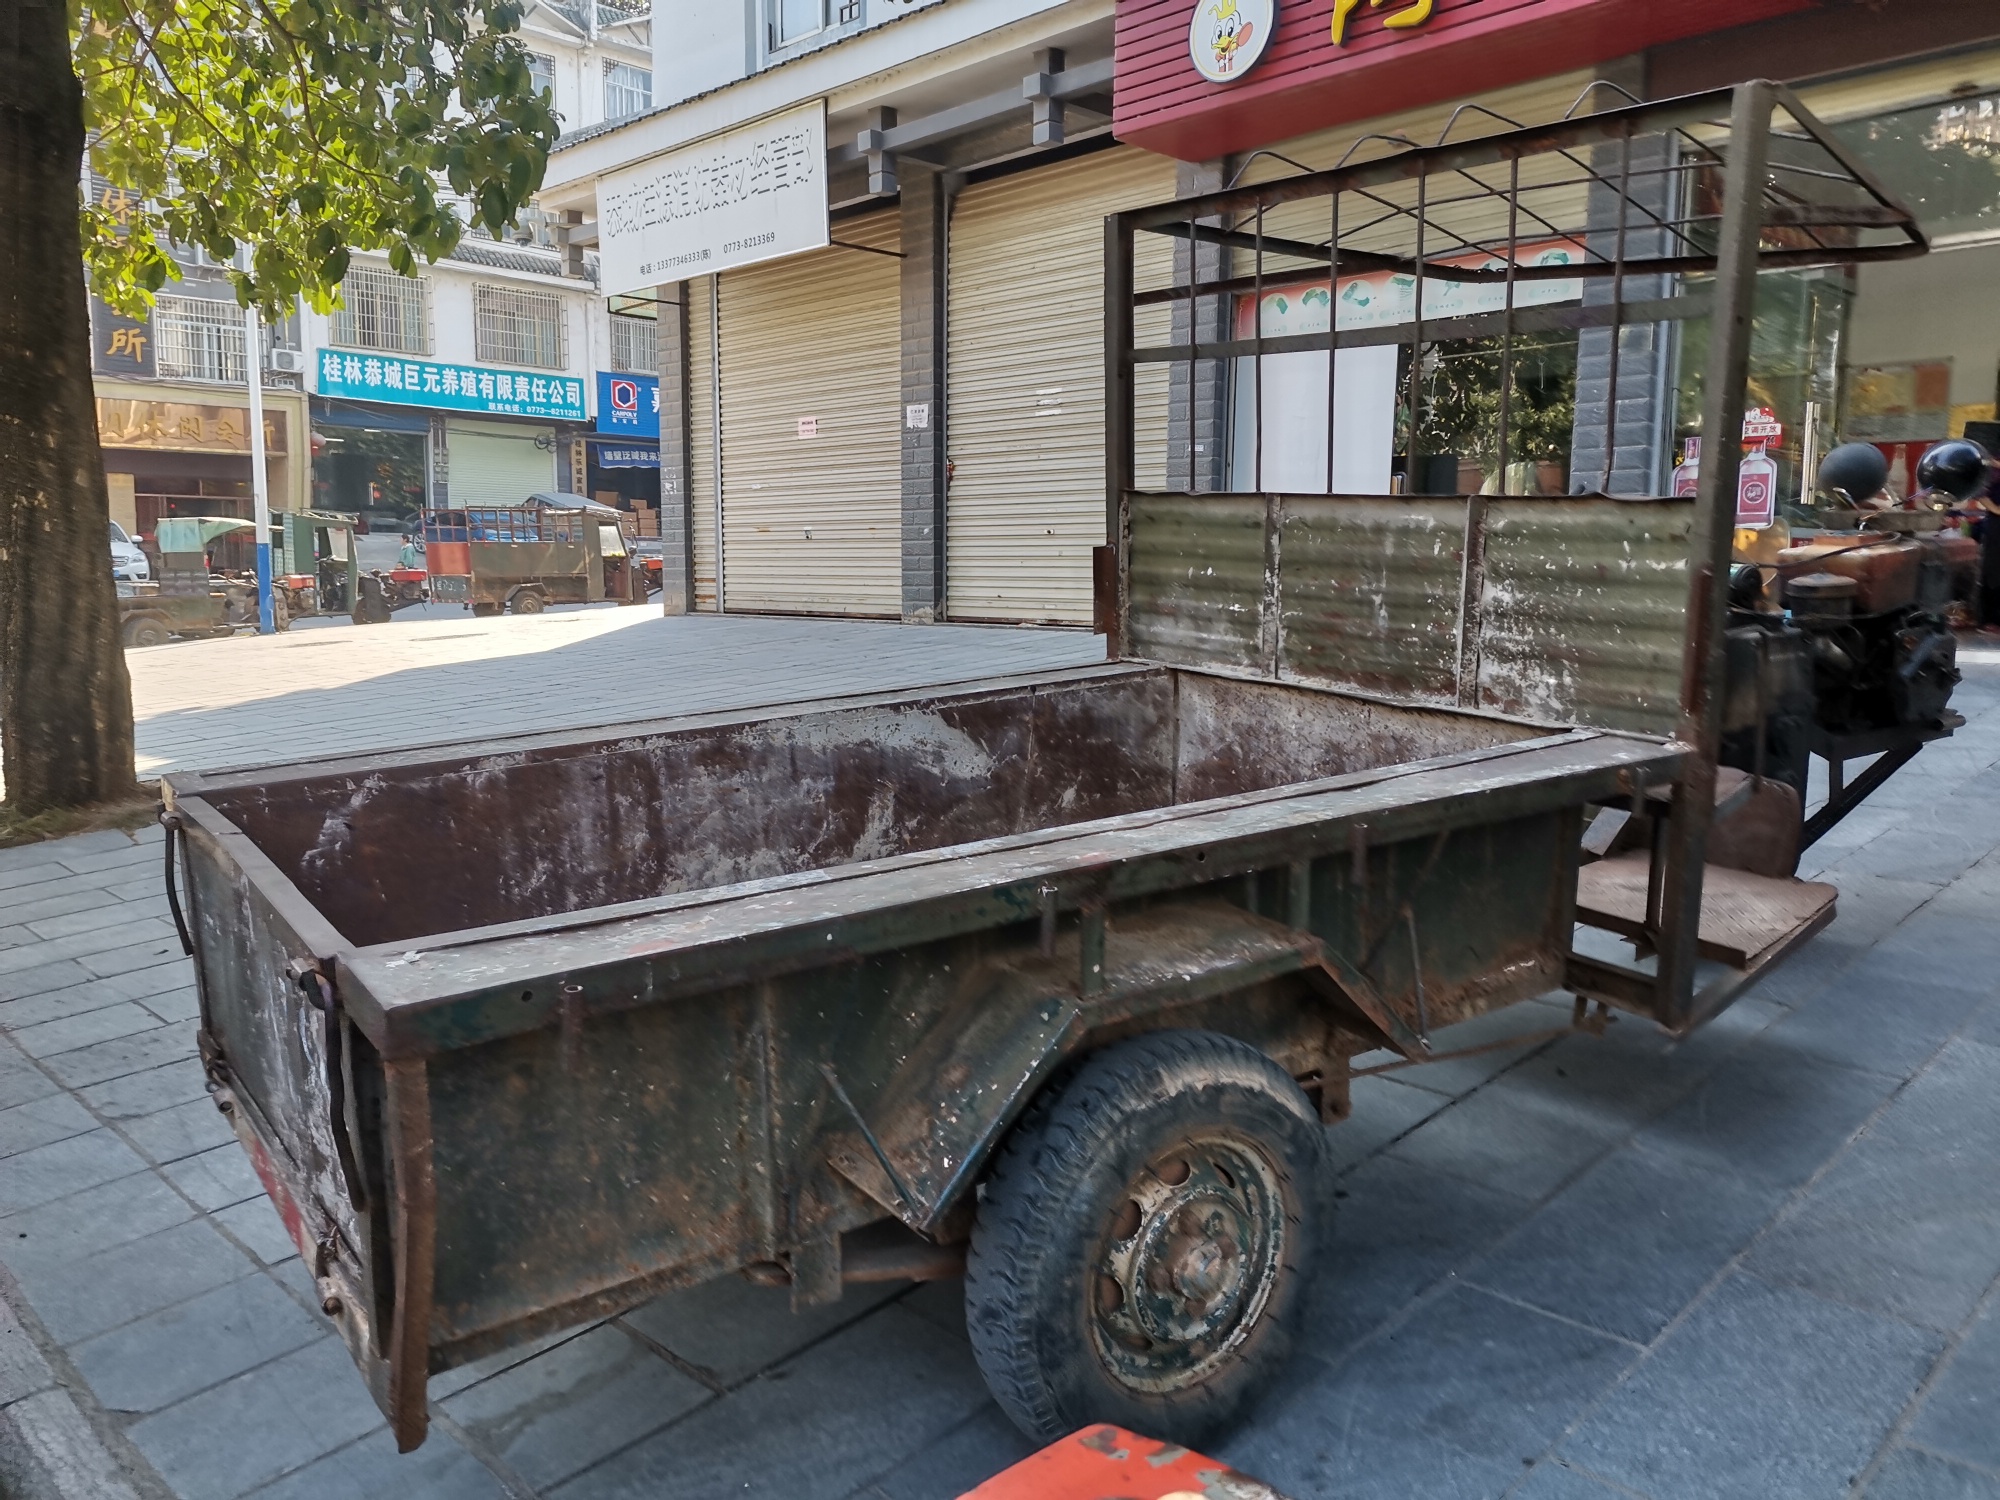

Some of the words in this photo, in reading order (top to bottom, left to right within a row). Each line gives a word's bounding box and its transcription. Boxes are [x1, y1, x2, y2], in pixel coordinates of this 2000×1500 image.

[723, 231, 776, 255] 0773-8213369
[323, 353, 581, 407] 桂林恭城巨元养殖有限责任公司
